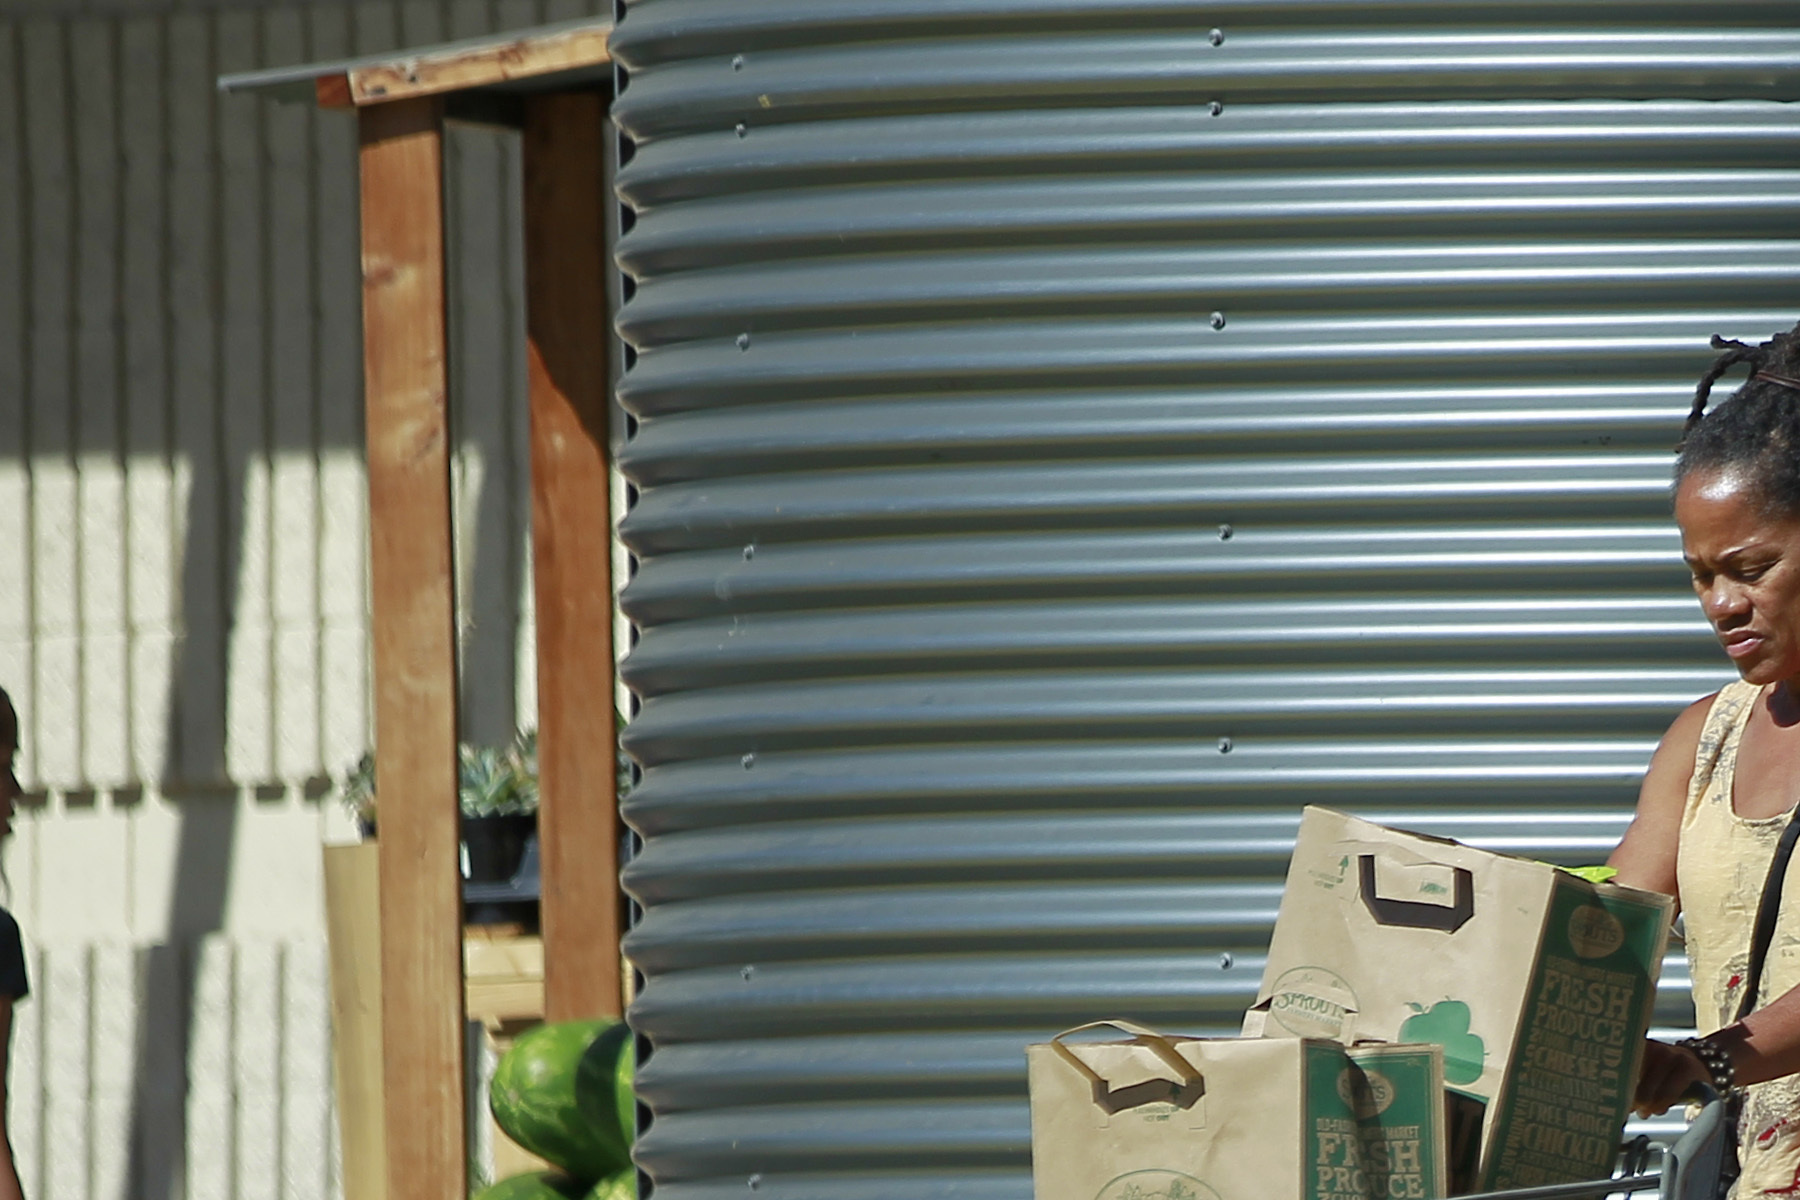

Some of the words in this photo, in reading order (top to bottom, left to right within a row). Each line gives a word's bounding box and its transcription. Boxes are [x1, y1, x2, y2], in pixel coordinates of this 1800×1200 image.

[1539, 968, 1635, 1021] FRESH
[1533, 1001, 1627, 1047] PRODUCE
[1522, 1122, 1610, 1167] CHICKEN
[1316, 1166, 1424, 1199] PROUCE
